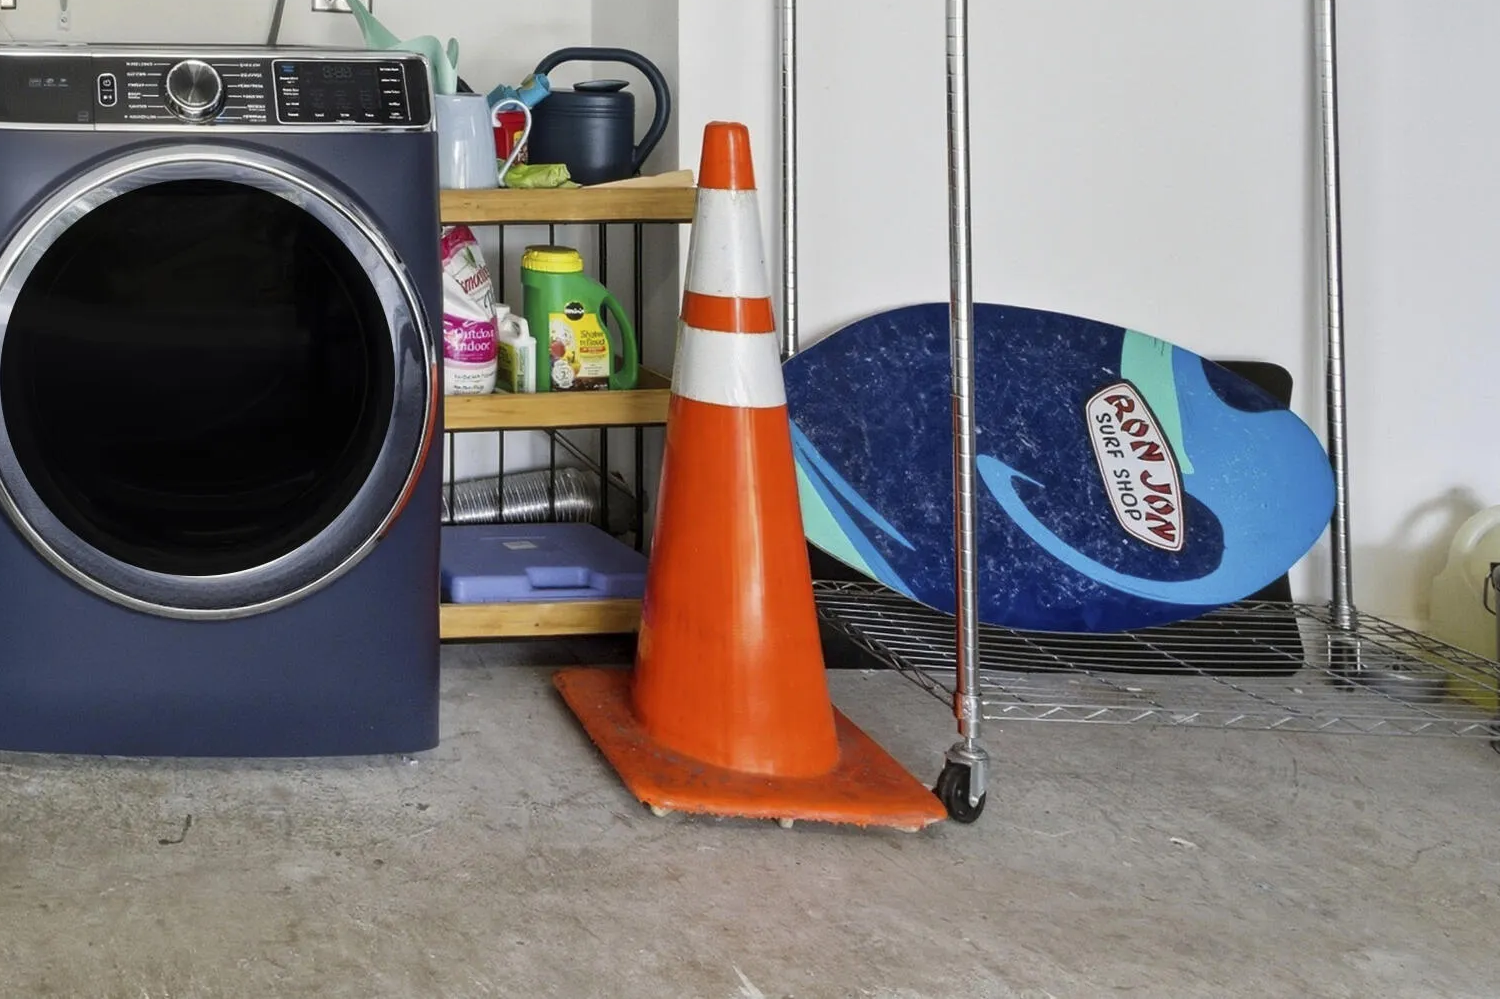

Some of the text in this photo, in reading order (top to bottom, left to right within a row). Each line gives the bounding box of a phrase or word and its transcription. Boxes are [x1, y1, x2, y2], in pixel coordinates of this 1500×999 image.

[1095, 412, 1143, 521] SURF SHOP
[1104, 394, 1177, 543] RON JON
